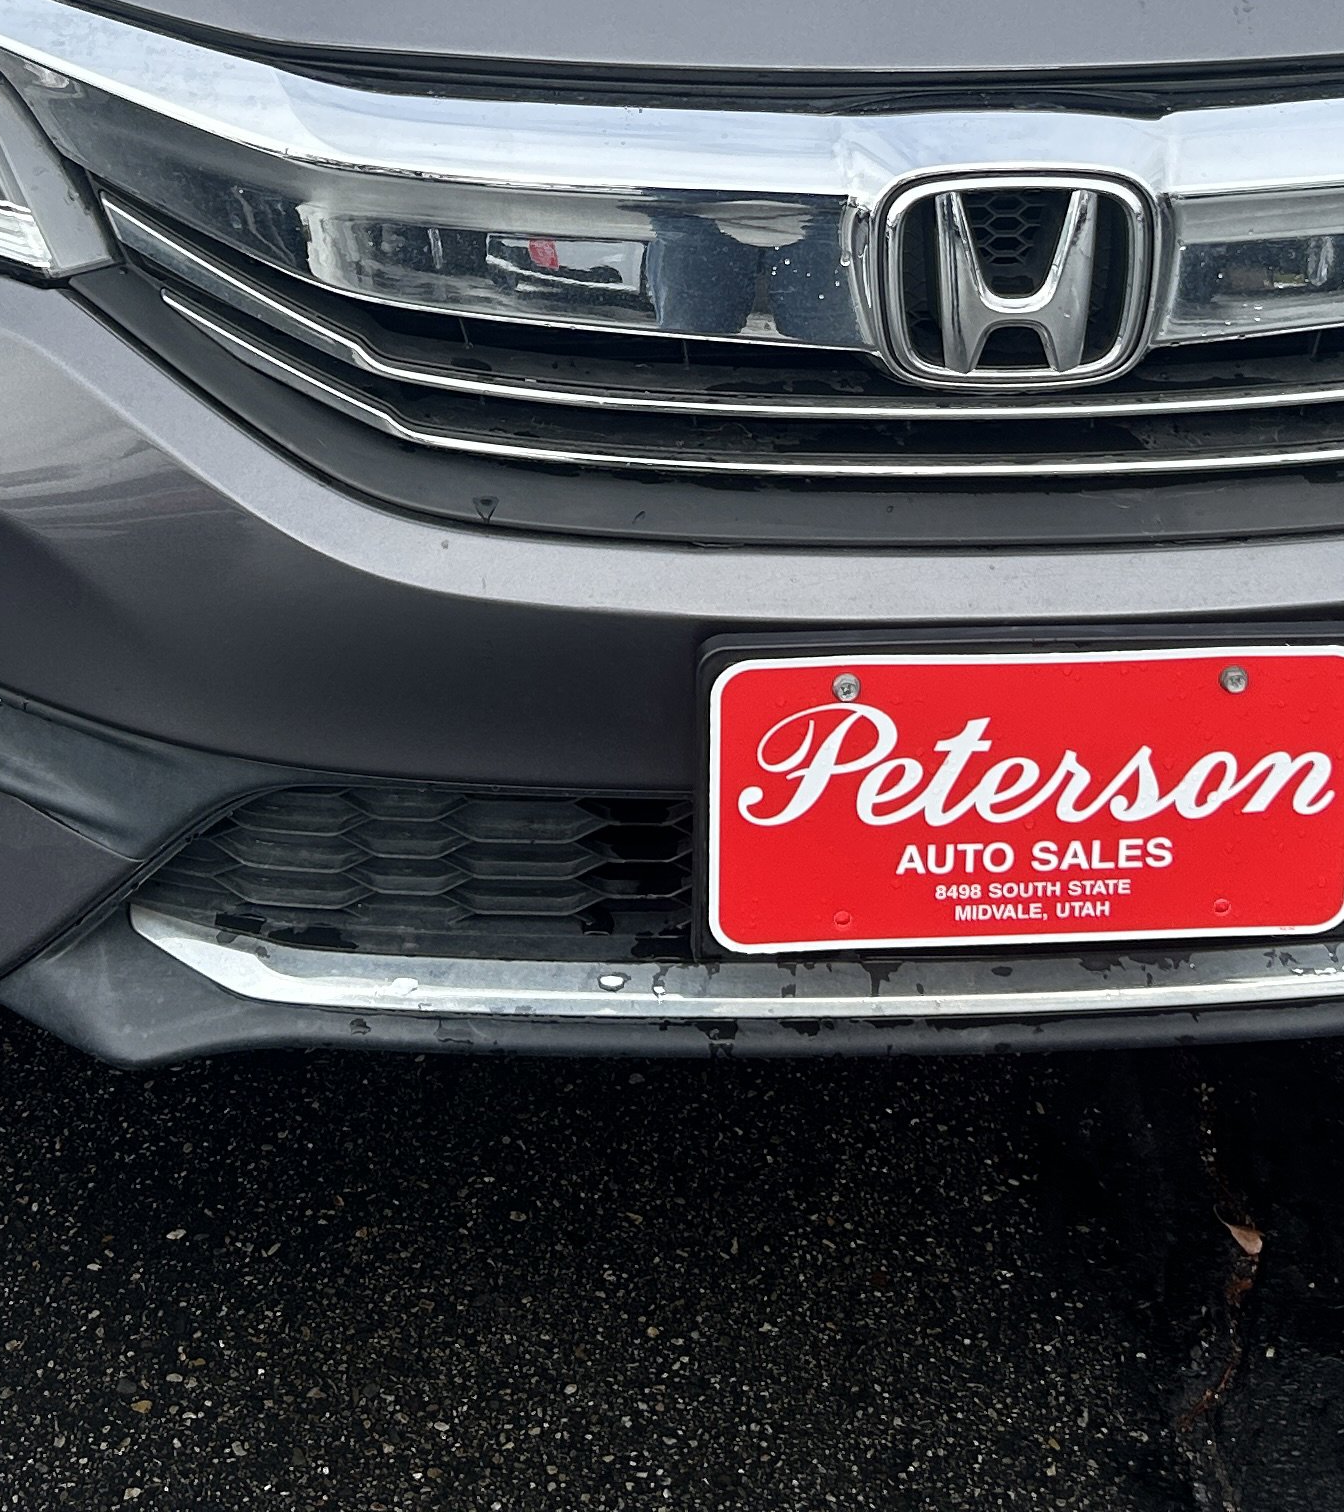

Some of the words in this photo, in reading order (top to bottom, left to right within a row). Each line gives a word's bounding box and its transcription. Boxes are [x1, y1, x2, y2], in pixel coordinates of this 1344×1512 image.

[737, 701, 1336, 828] Peterson
[895, 841, 1016, 876] AUTO
[1030, 837, 1174, 871] SALES
[934, 883, 983, 901] 8498
[988, 880, 1062, 899] SOUTH
[1067, 878, 1132, 897] STATE
[954, 902, 1049, 922] MIDVALE,
[1056, 900, 1111, 918] UTAH
